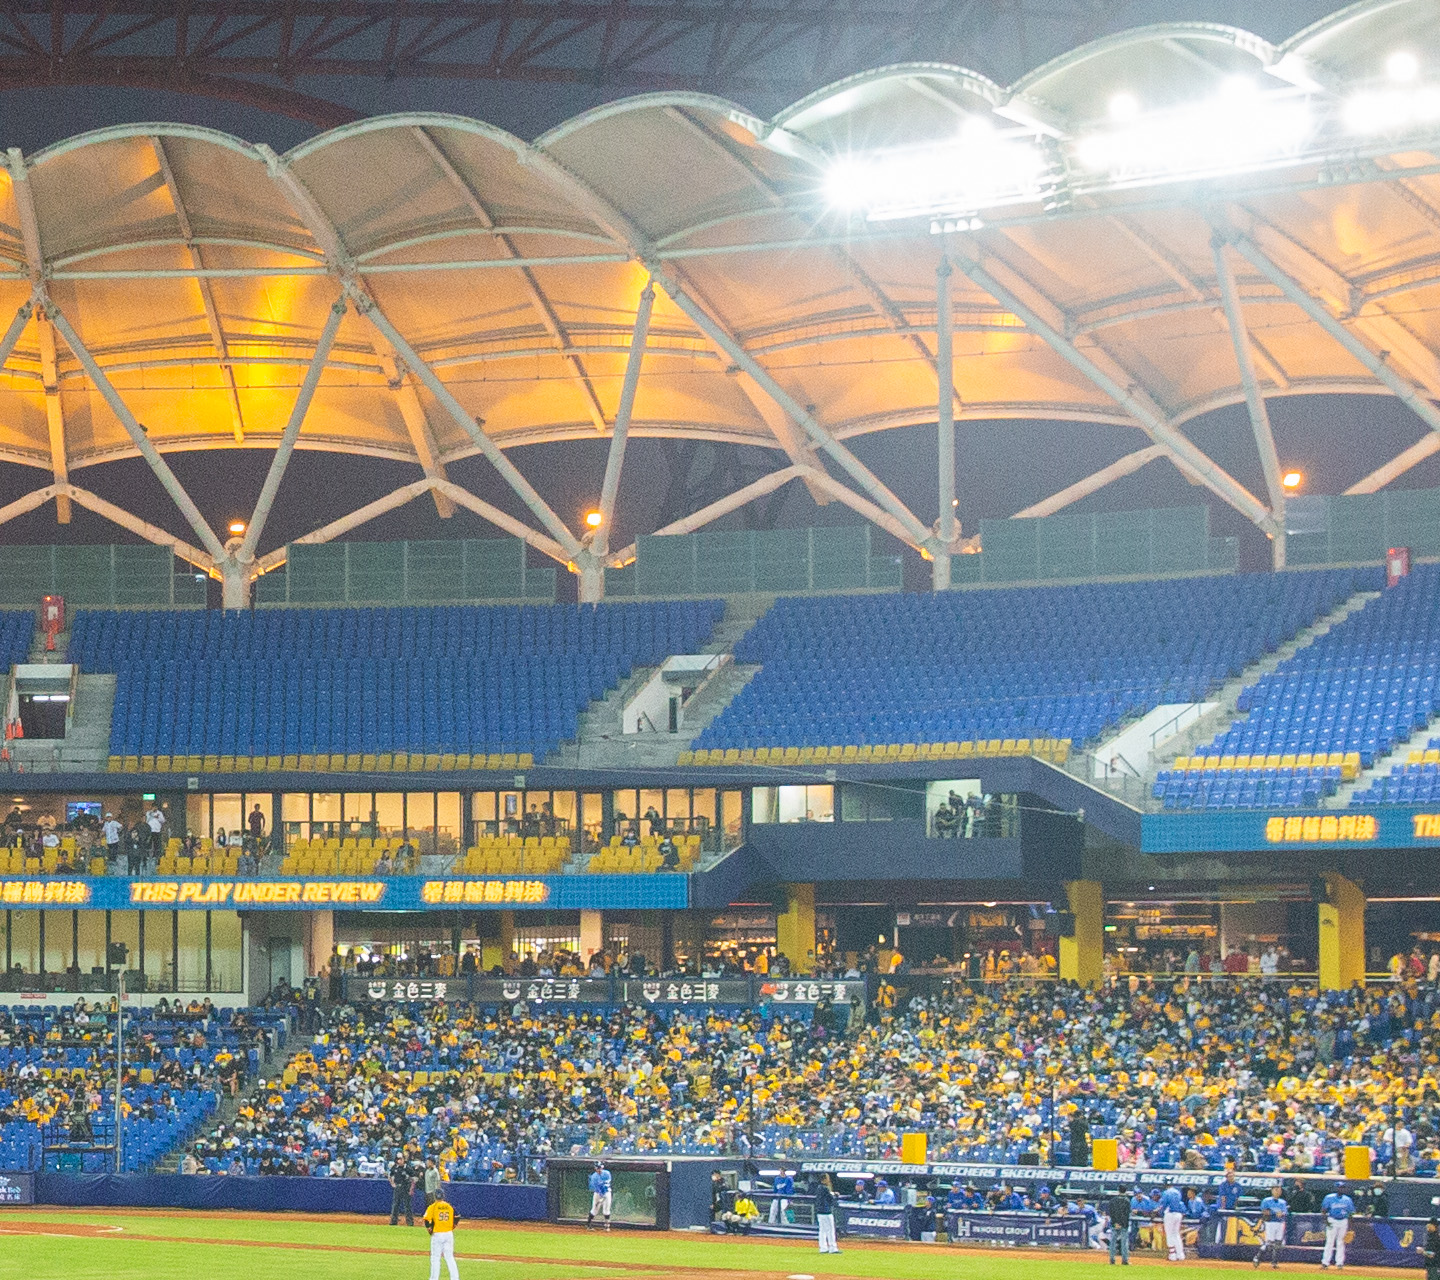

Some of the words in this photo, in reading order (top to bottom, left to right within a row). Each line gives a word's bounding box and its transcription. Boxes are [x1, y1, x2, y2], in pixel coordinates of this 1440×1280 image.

[131, 882, 177, 901] THIS
[178, 882, 233, 902] PLAY
[233, 882, 302, 902] UNDER
[302, 882, 384, 902] REVIEW
[393, 983, 447, 999] 金色三麥
[527, 983, 580, 999] 金色三麥
[801, 1162, 862, 1172] SKECHERS
[866, 1164, 927, 1175] SKECHERS
[931, 1166, 997, 1177] SKECHERS
[1000, 1168, 1065, 1180] SKECHERS
[1069, 1171, 1136, 1182] SKECHERS
[848, 1217, 901, 1228] SKECHERS
